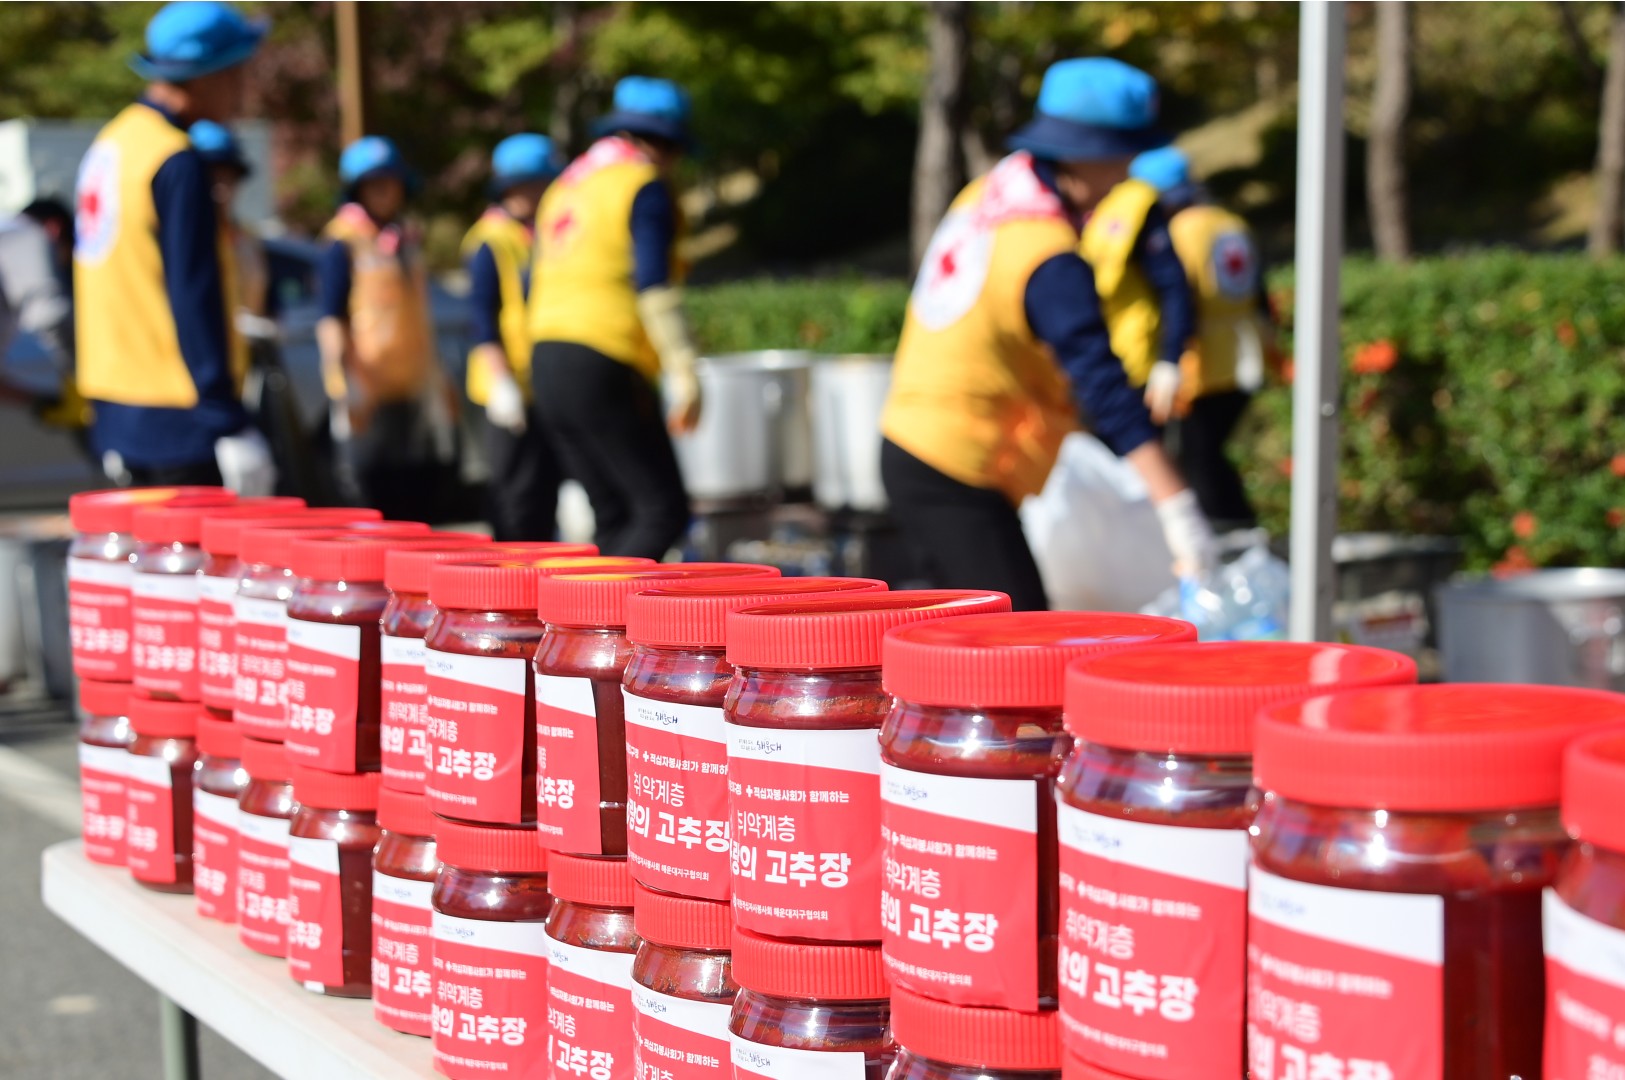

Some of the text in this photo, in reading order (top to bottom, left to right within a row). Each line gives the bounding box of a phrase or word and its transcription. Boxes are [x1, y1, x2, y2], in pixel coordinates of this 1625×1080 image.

[436, 746, 496, 781] 고추장
[650, 753, 699, 773] 적십자봉사회가
[701, 762, 728, 775] 함께하
[634, 771, 685, 807] 취약계층
[754, 787, 806, 803] 적십자봉사회가
[809, 790, 850, 803] 함께하는
[661, 864, 709, 881] 해운대지구협의회
[765, 850, 852, 888] 고추장
[773, 906, 829, 921] 해운대지구협의회
[907, 903, 999, 953] 고추장
[1093, 962, 1199, 1022] 고추장
[457, 1014, 527, 1046] 고추장
[556, 1039, 614, 1080] 고추장
[686, 1052, 719, 1068] 함께하는
